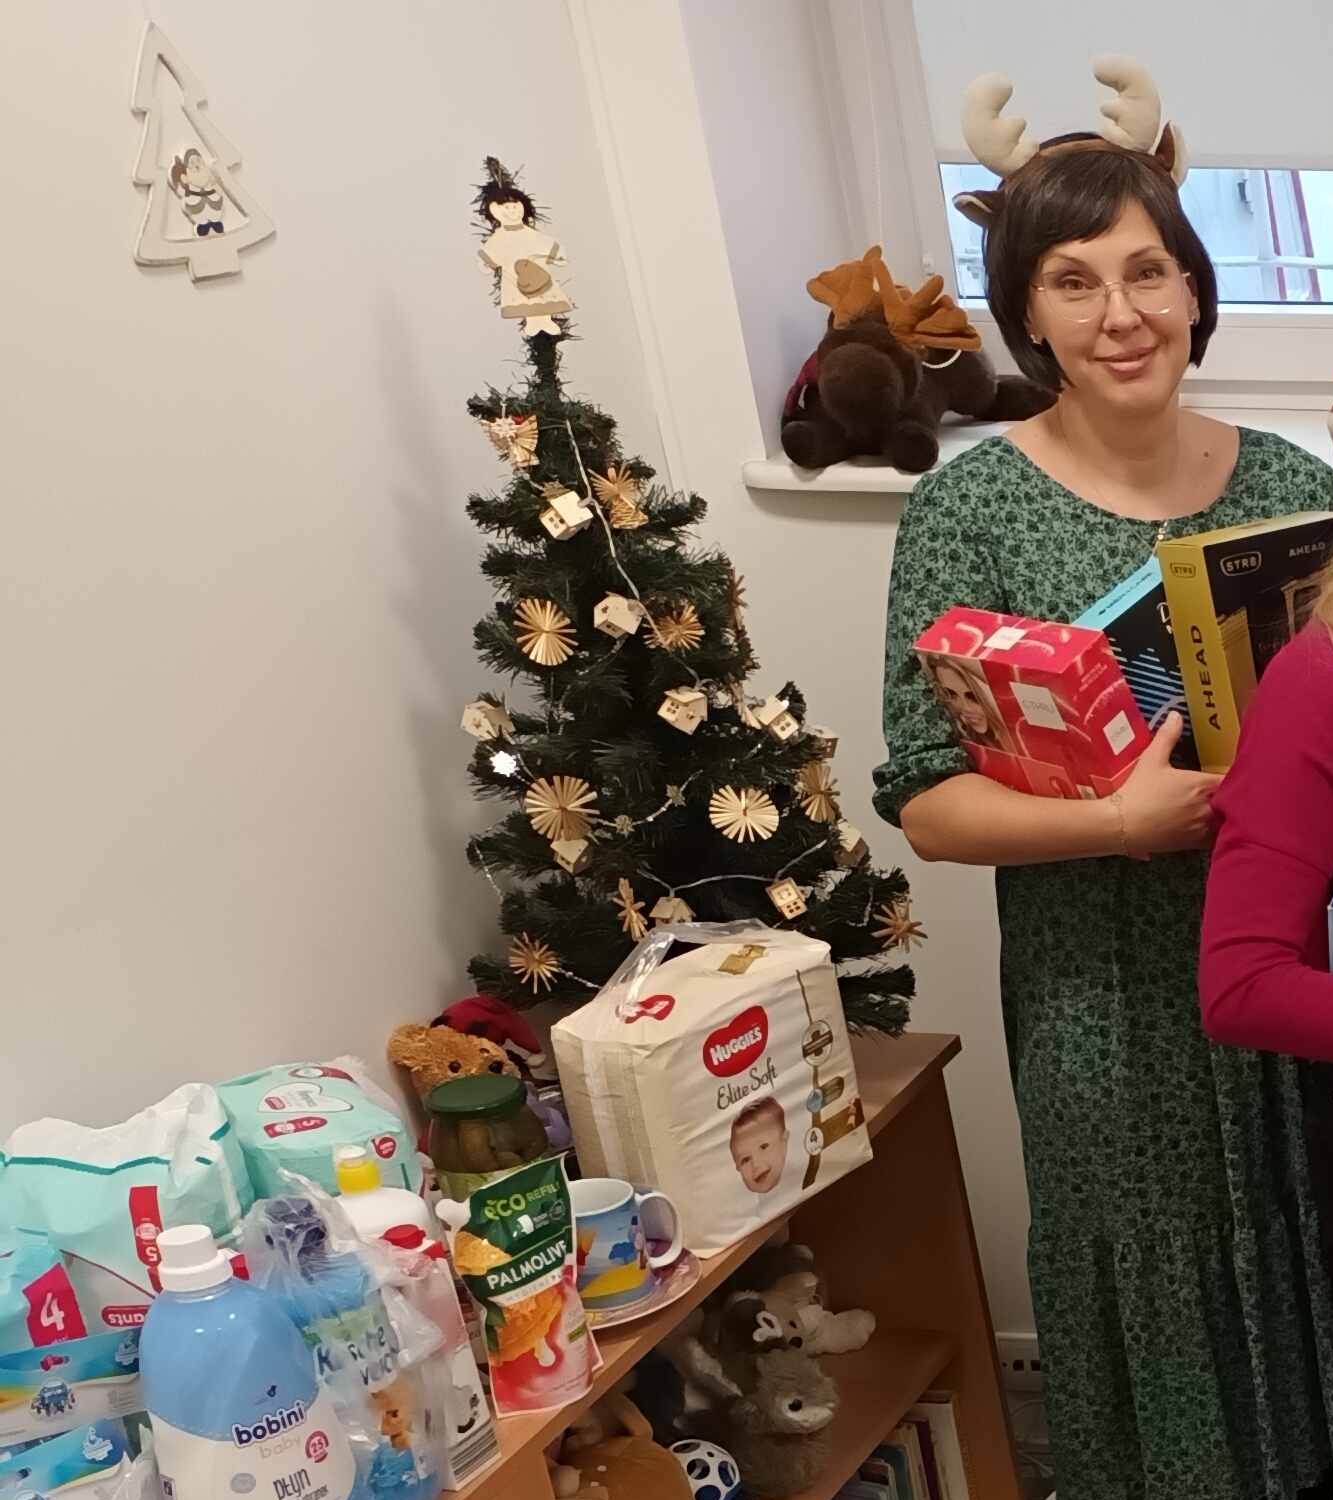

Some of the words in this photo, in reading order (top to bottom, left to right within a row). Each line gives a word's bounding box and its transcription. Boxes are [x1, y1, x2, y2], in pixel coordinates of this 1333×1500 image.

[1226, 555, 1257, 572] STR8
[1289, 541, 1326, 558] AHEAD
[1173, 566, 1193, 575] STR8
[1190, 625, 1221, 731] AHEAD
[709, 1025, 762, 1066] HUGGIES
[717, 1084, 749, 1110] Elite
[750, 1057, 778, 1091] Soft
[486, 1239, 568, 1290] PALMOLIVE
[39, 1292, 66, 1332] 4
[235, 1401, 305, 1445] bobini
[258, 1436, 301, 1460] baby
[311, 1440, 325, 1455] 25
